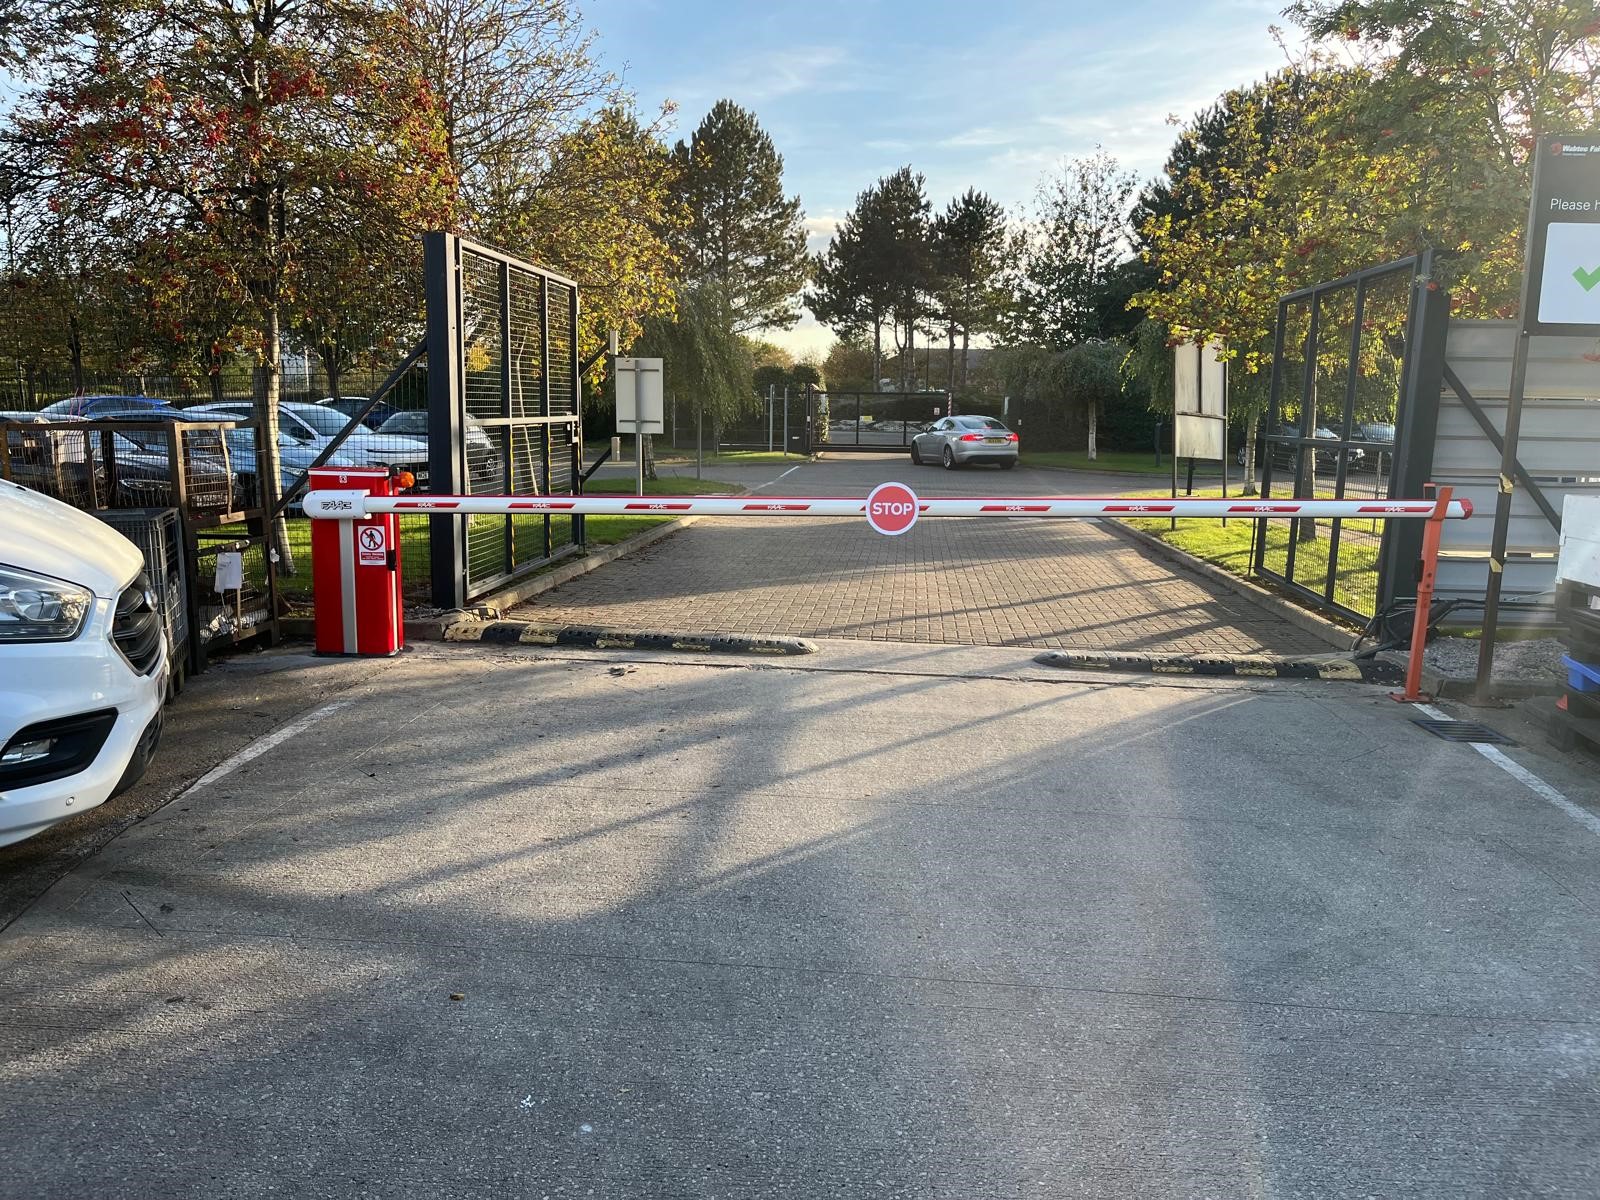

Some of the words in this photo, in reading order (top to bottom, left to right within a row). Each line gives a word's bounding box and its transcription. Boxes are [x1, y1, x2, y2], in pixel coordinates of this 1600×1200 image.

[1550, 198, 1591, 210] Please
[320, 501, 353, 511] FAAC
[872, 502, 913, 516] STOP
